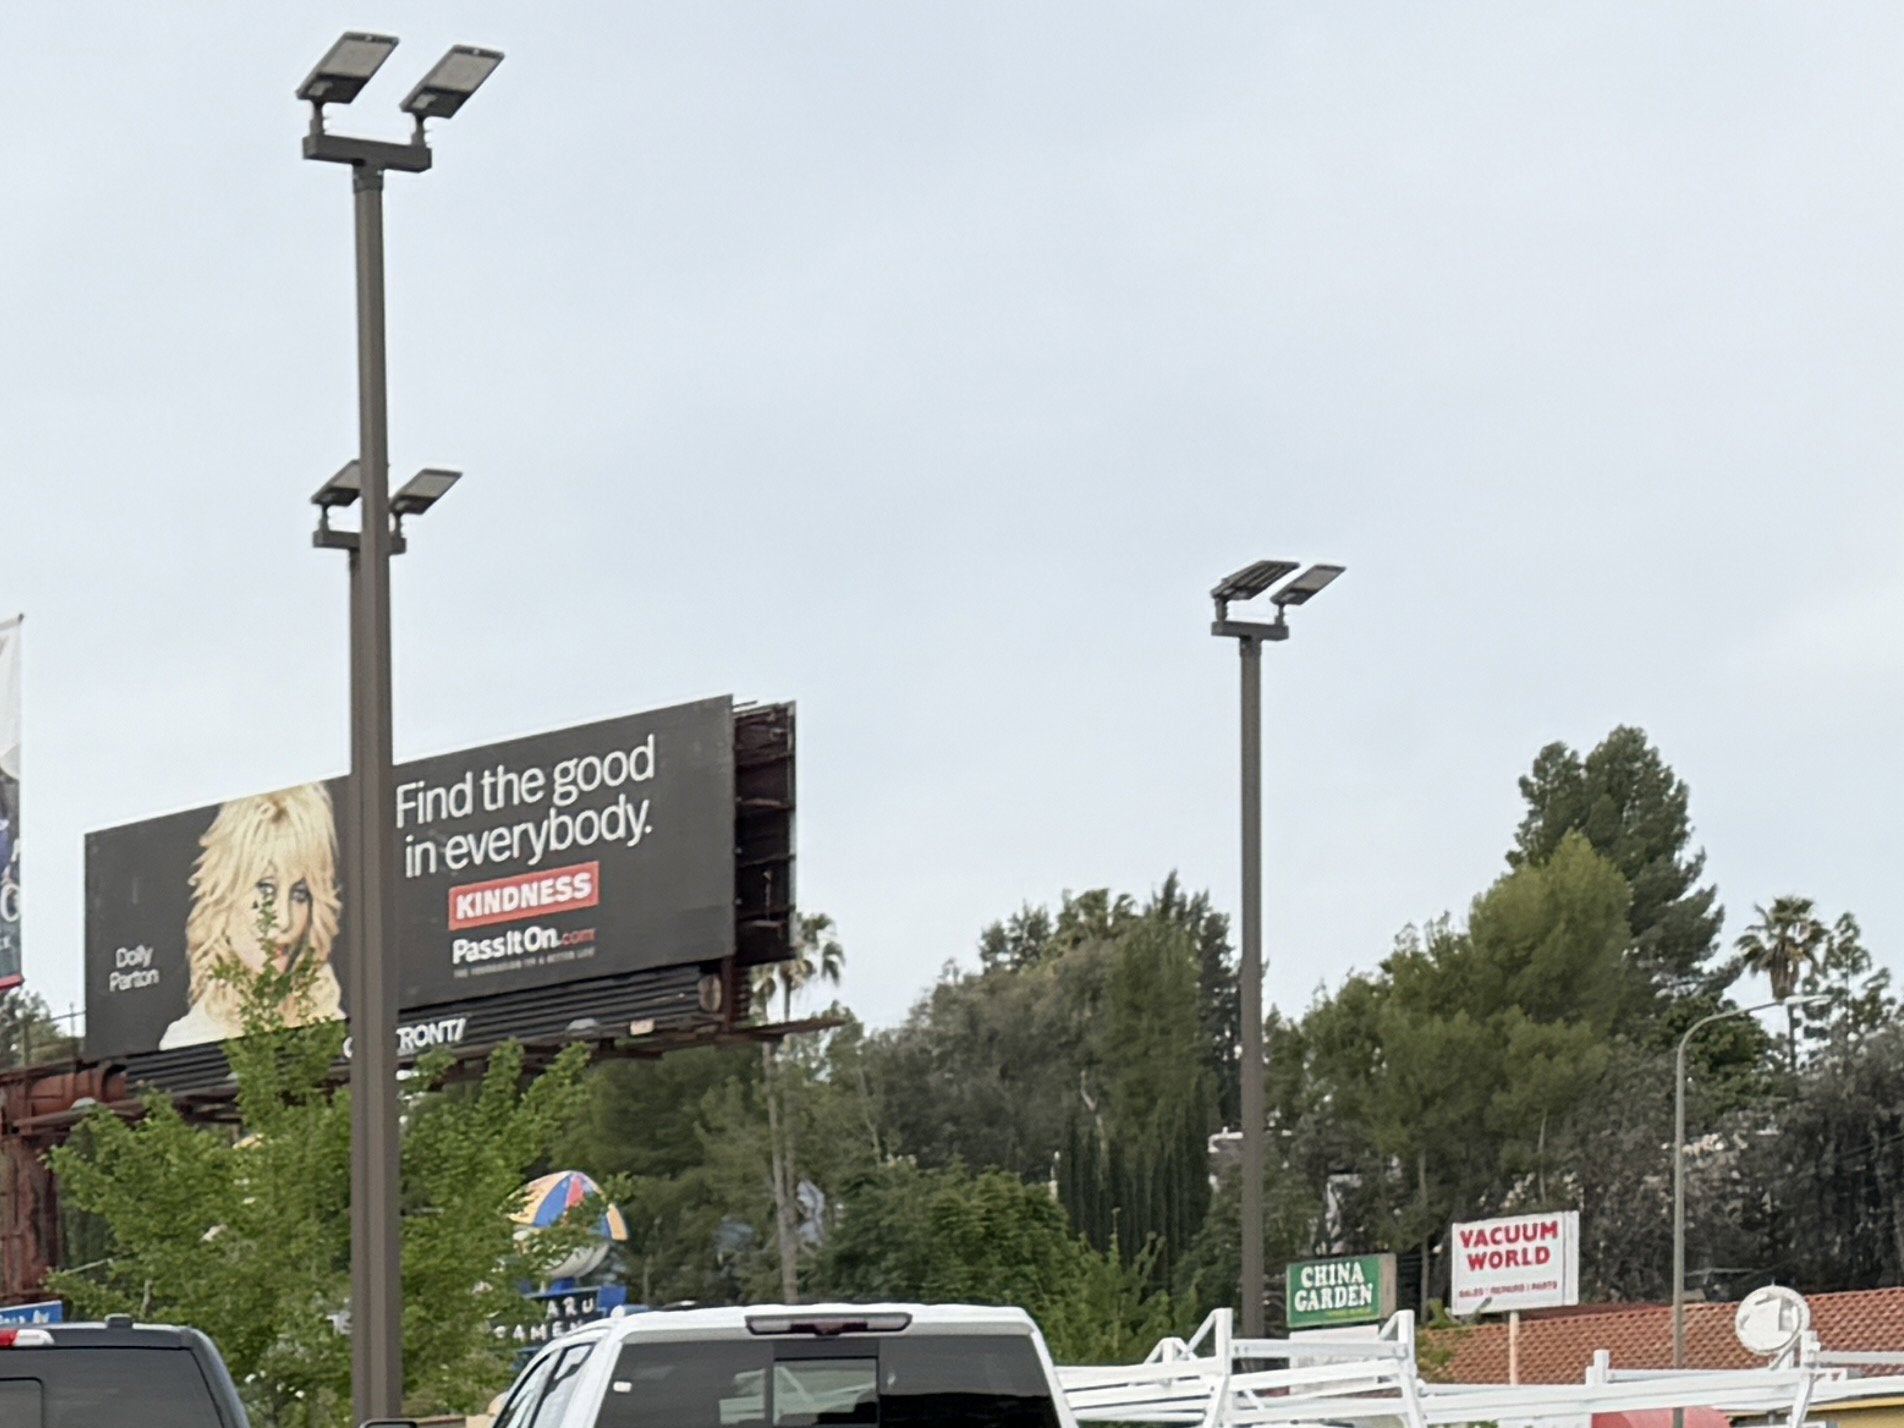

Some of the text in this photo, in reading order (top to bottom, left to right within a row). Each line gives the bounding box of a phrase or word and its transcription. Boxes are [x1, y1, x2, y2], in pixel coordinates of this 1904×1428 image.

[395, 733, 655, 829] Find the good
[405, 793, 653, 879] in everybody.
[455, 872, 593, 921] KINDNESS
[1459, 1220, 1558, 1249] VACUUM
[1467, 1246, 1550, 1272] WORLD
[1300, 1262, 1365, 1288] CHINA
[1294, 1283, 1374, 1312] GARDEN
